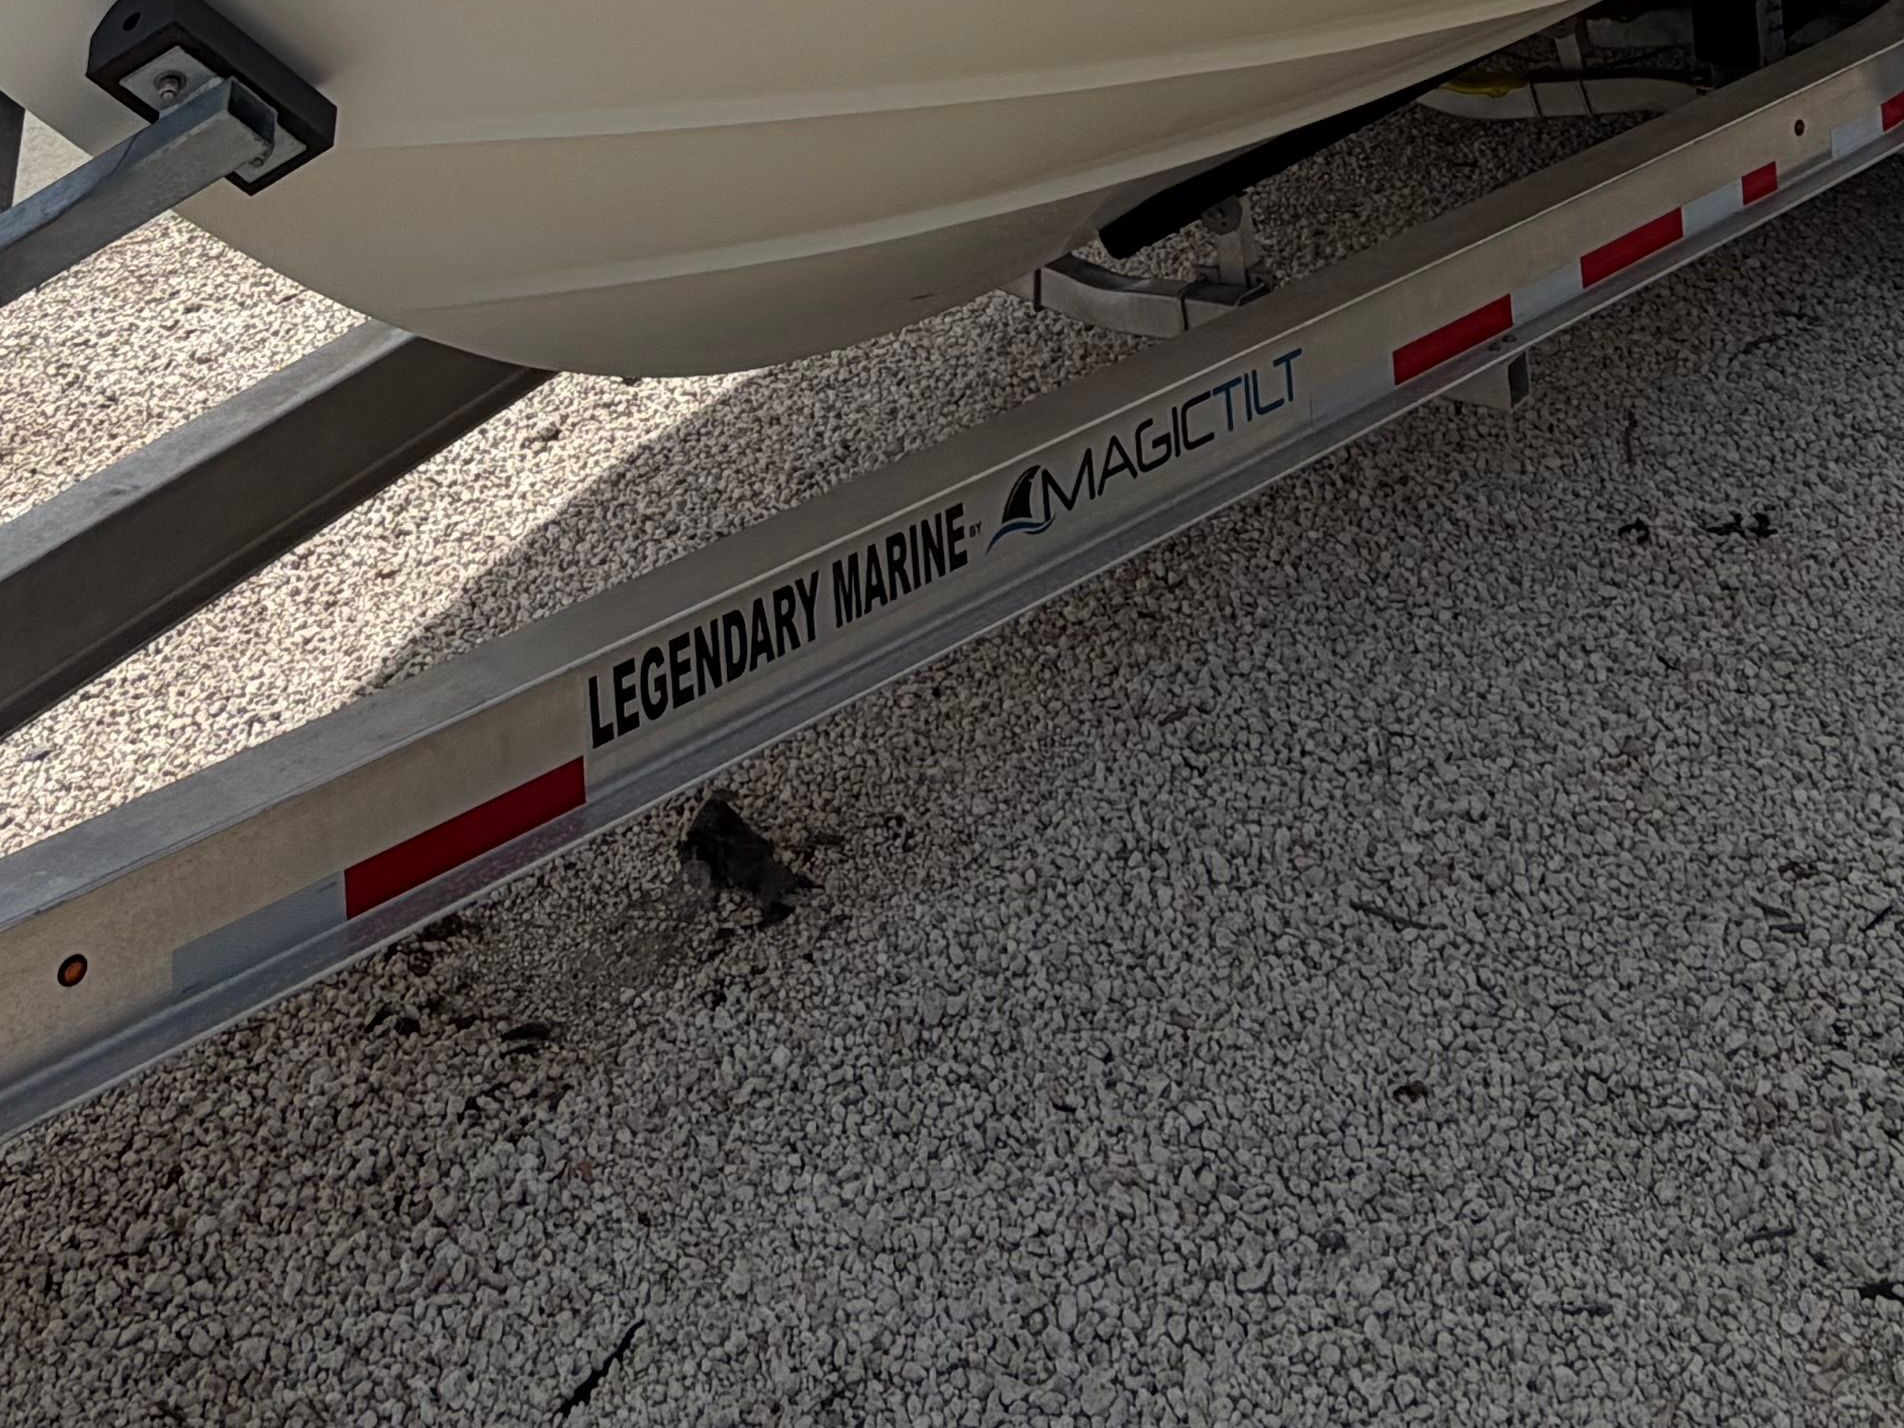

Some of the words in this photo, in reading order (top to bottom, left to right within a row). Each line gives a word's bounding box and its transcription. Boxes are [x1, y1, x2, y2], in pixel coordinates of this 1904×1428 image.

[586, 568, 822, 749] LEGENDARY
[831, 501, 969, 630] MARINE
[969, 520, 983, 538] BY
[1041, 346, 1303, 518] MAGICTILT
